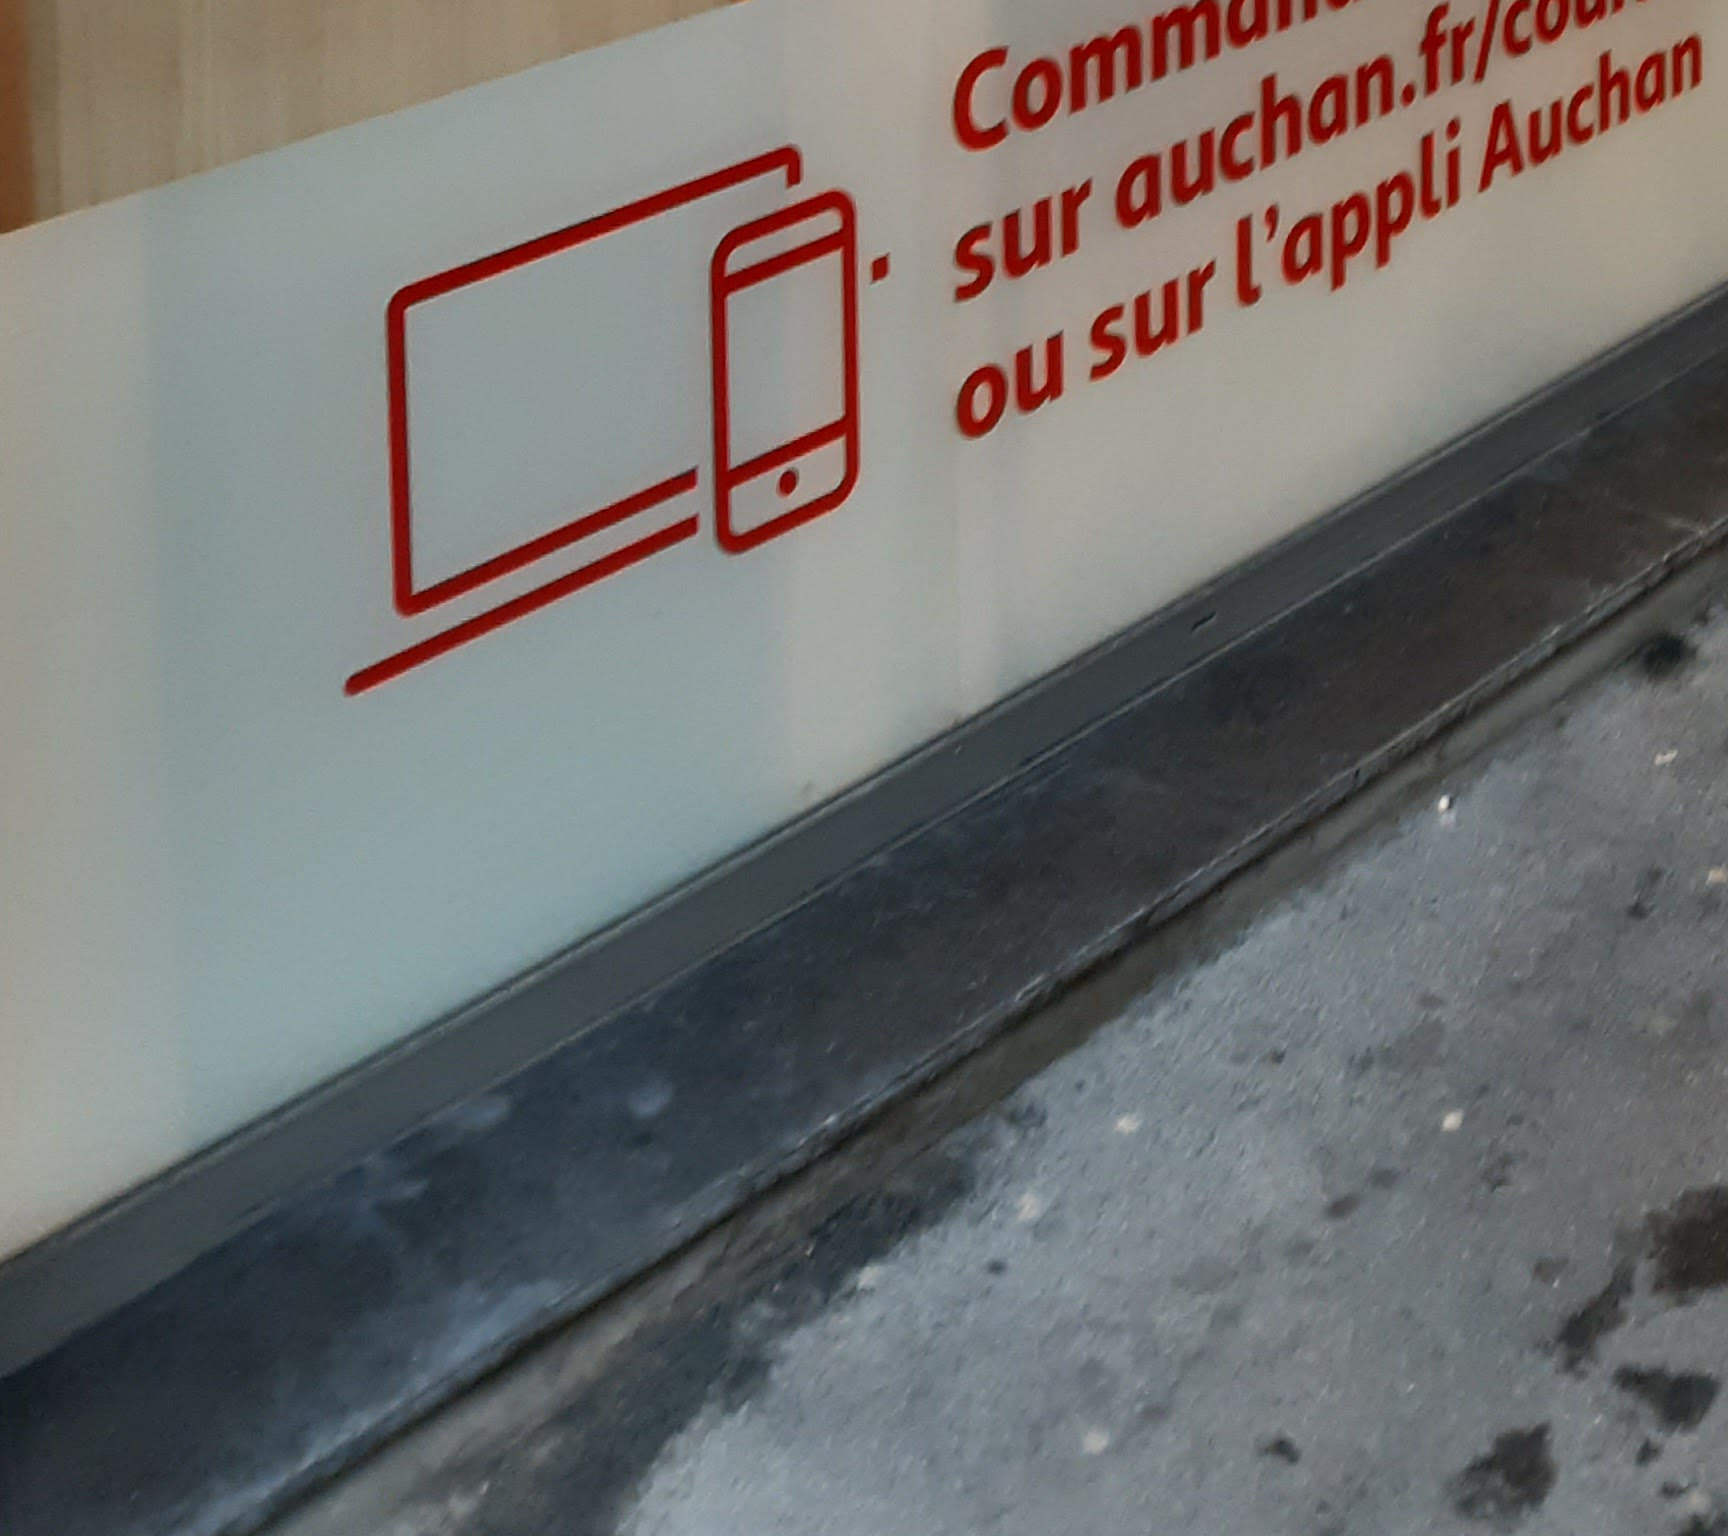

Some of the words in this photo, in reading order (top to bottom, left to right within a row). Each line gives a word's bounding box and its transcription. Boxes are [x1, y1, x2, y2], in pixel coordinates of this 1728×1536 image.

[954, 176, 1093, 303] sur
[955, 331, 1065, 441] ou
[1088, 259, 1216, 382] sur
[1478, 33, 1704, 194] Auchan
